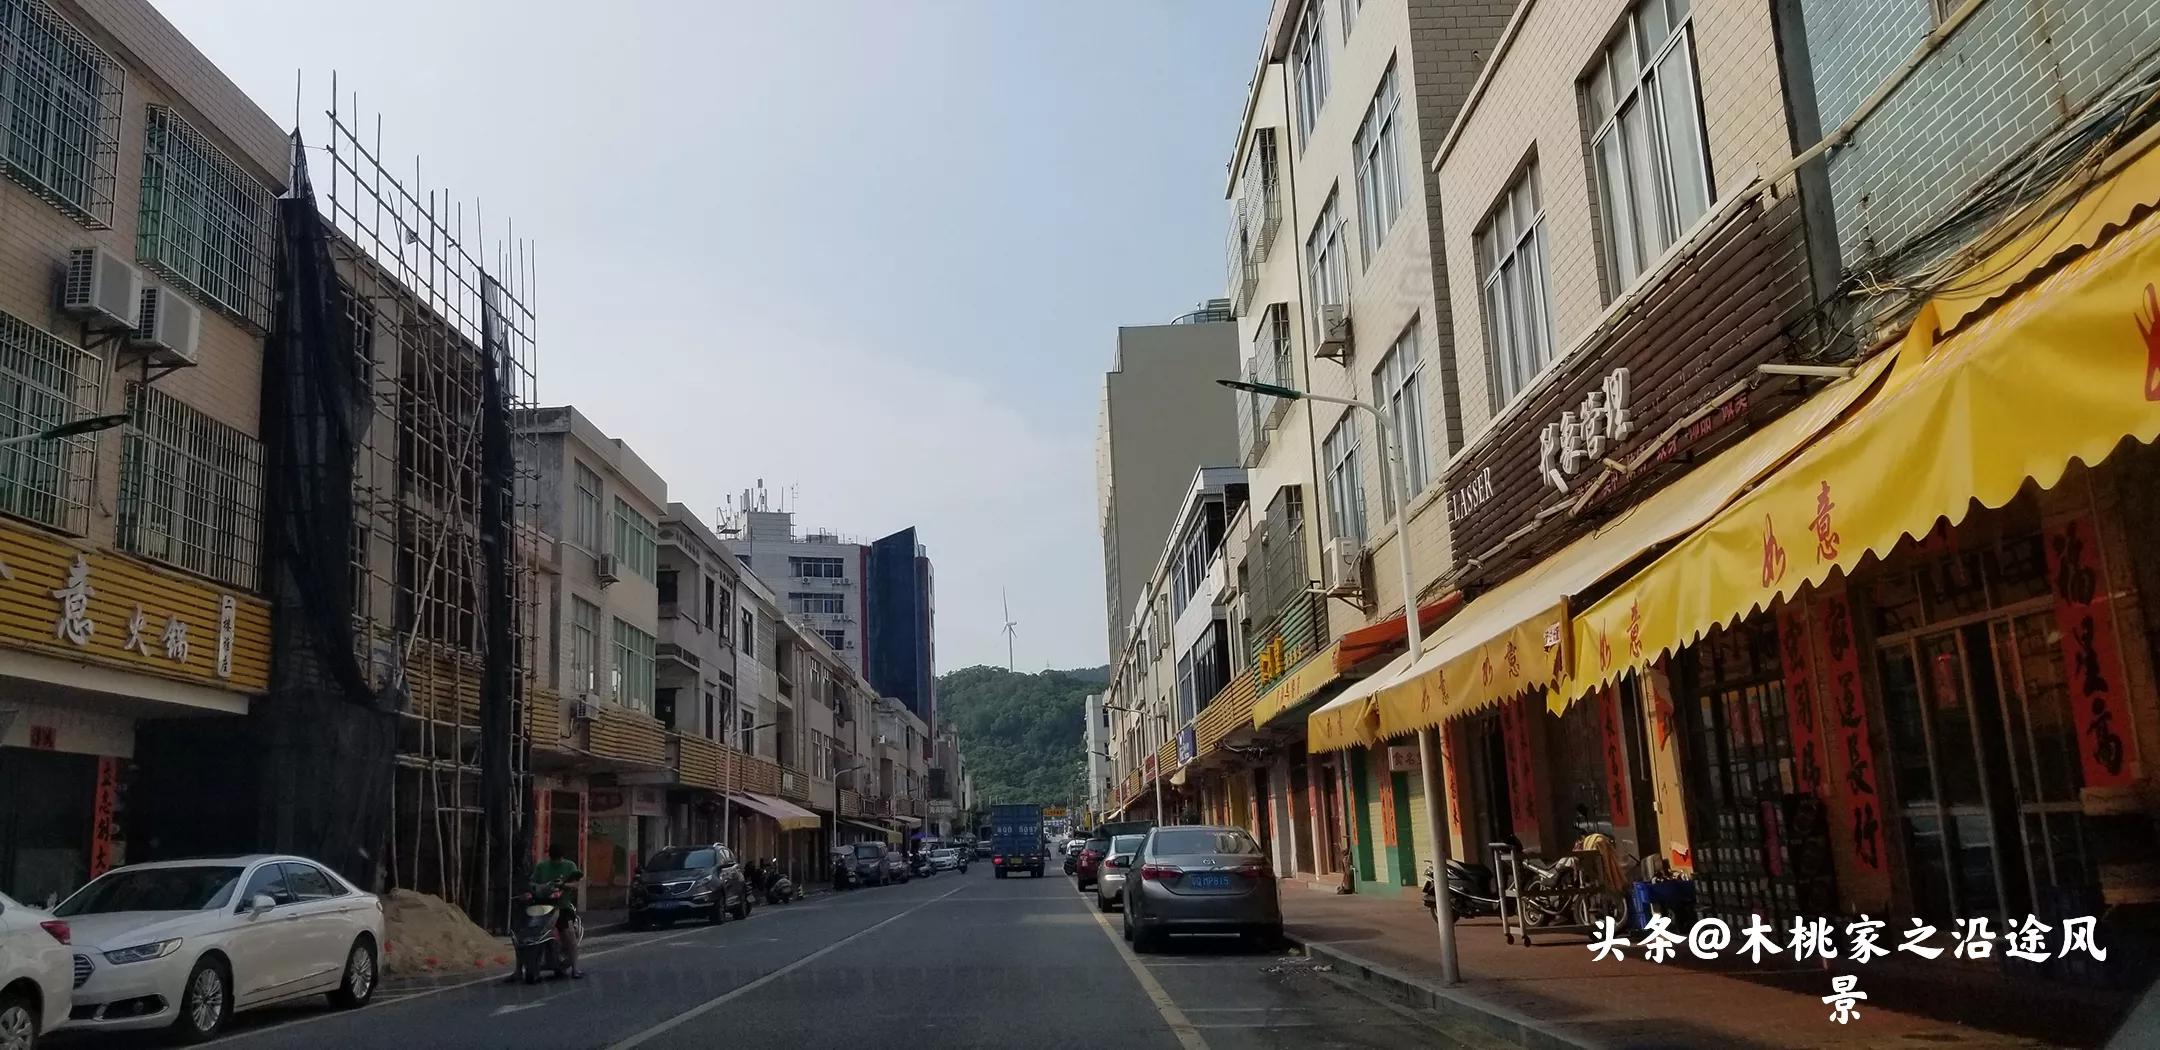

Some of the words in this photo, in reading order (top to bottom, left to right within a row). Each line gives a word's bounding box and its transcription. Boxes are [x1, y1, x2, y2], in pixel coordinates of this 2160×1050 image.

[1452, 466, 1494, 521] LASSER
[1761, 480, 1841, 589] 如意
[1481, 640, 1522, 688] 如意
[1600, 597, 1644, 673] 如意
